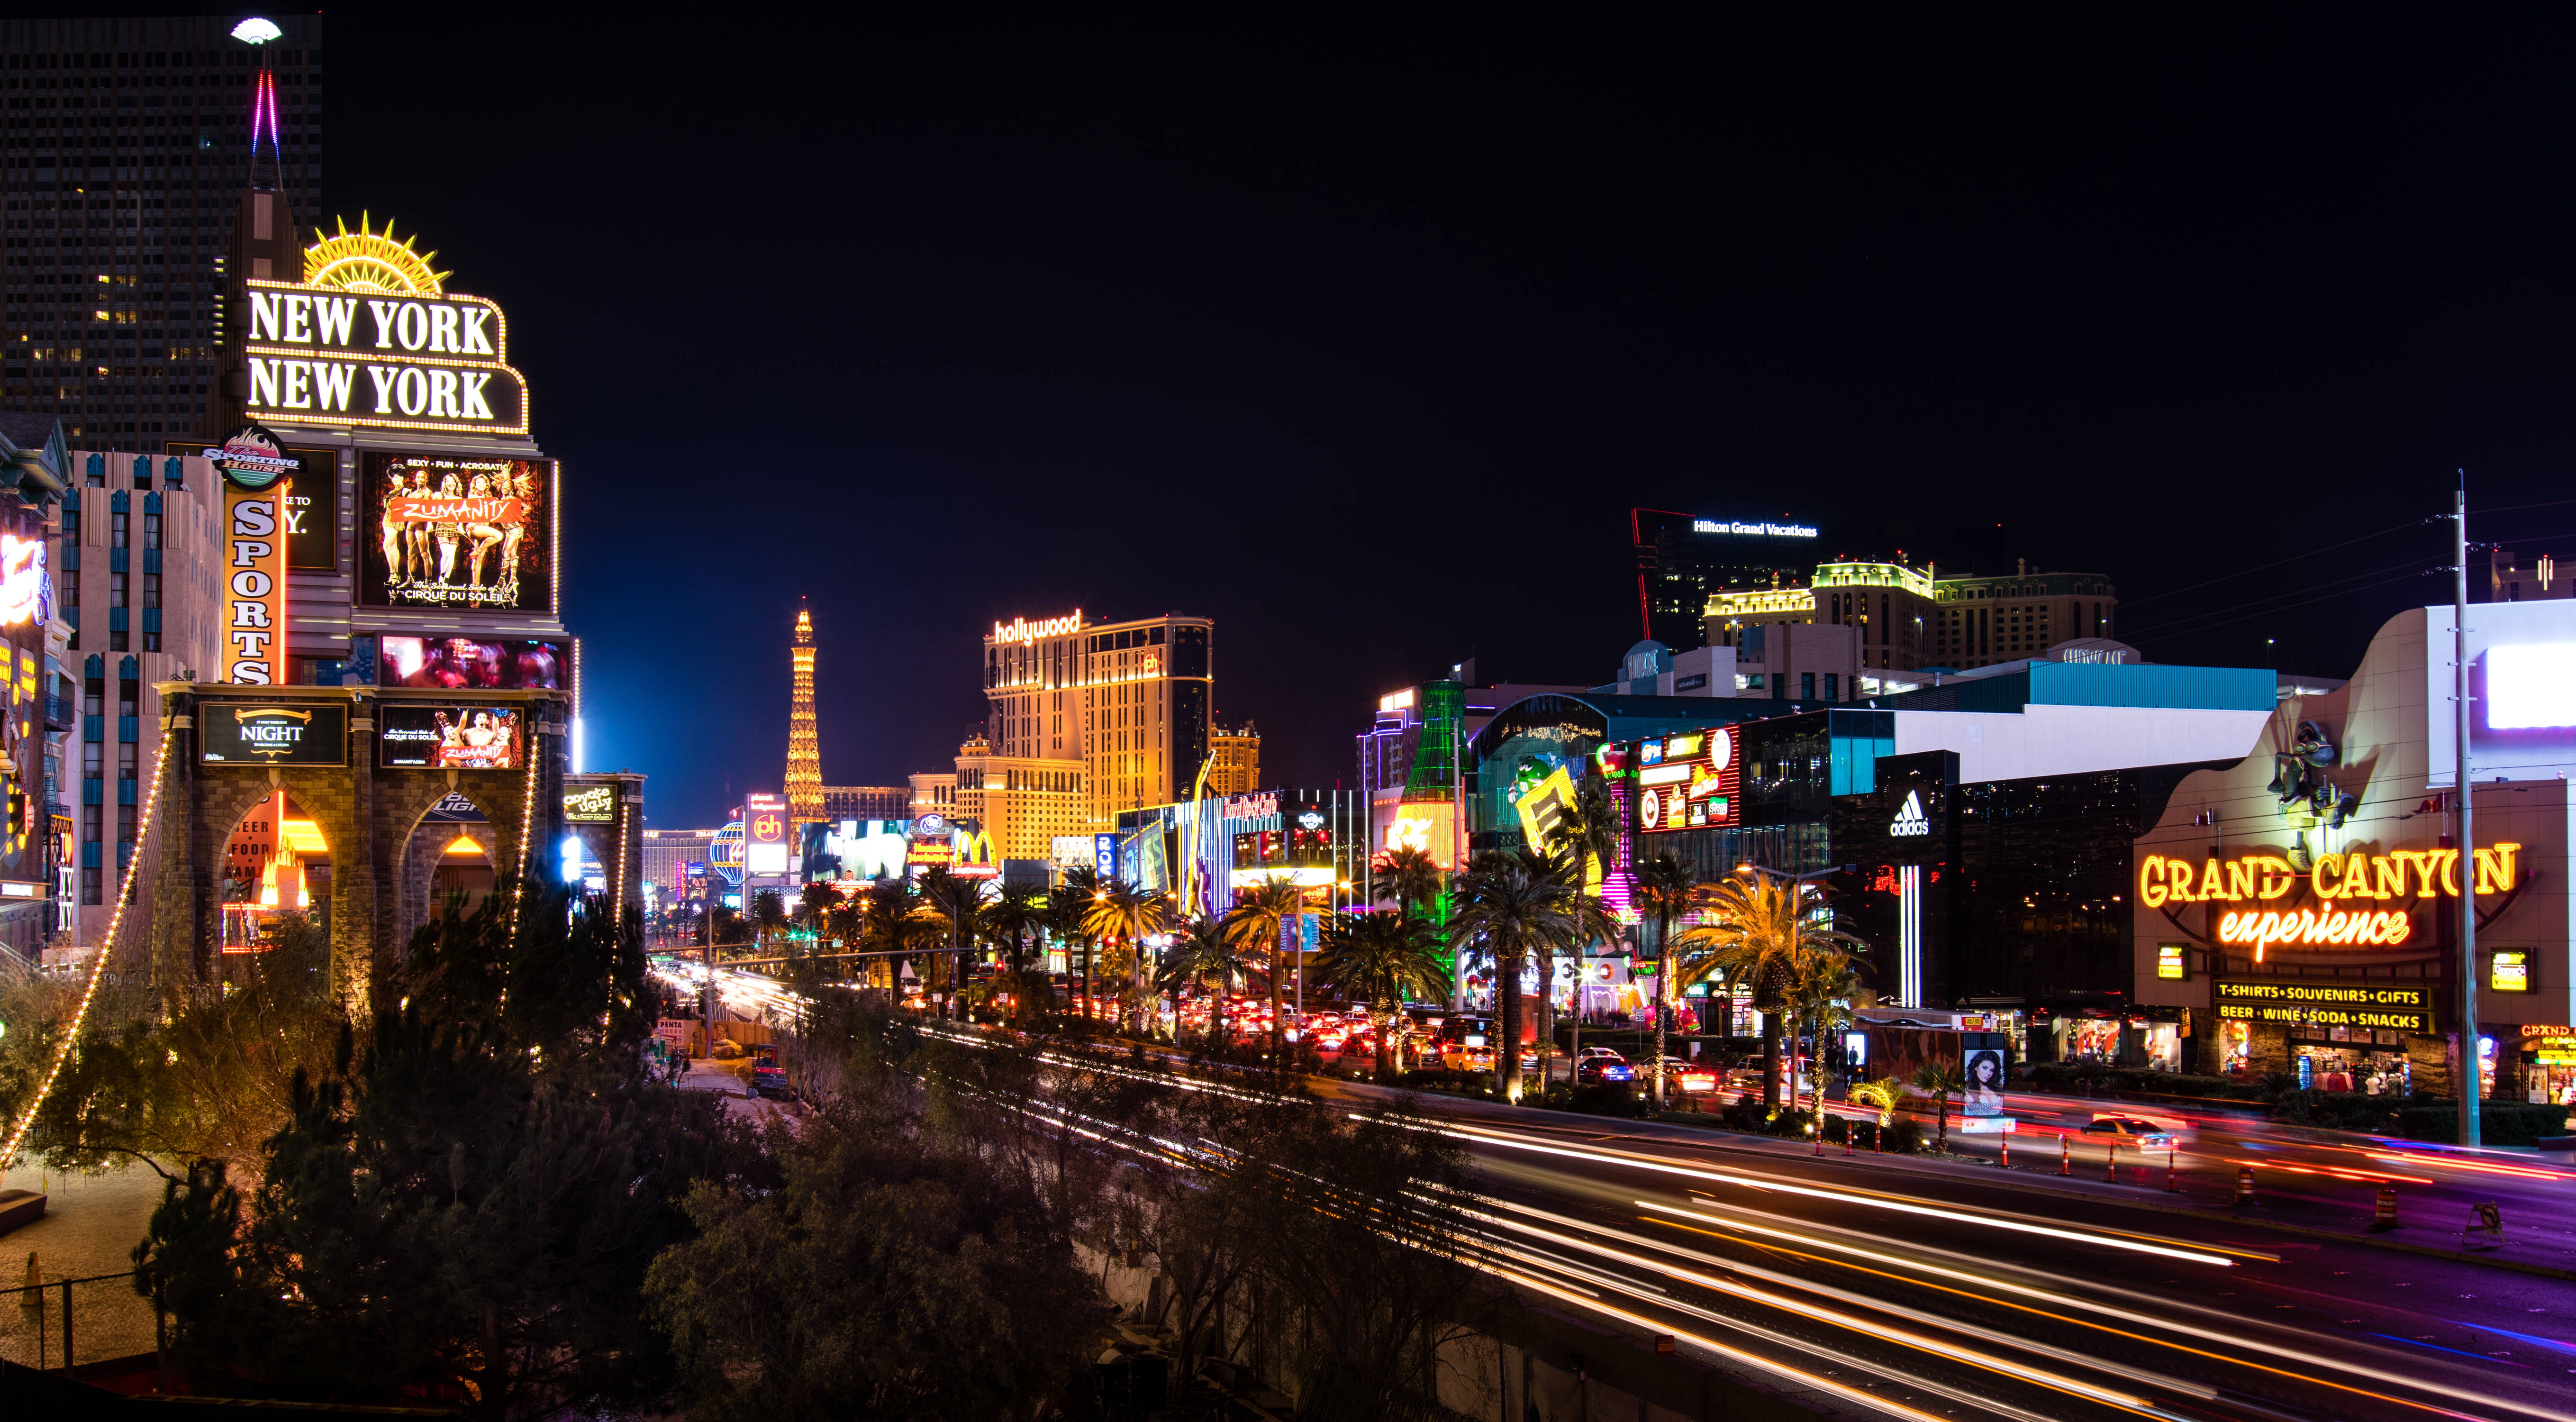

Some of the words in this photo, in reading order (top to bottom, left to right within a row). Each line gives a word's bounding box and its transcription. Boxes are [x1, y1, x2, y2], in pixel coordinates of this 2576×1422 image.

[249, 292, 357, 345] NEW
[368, 301, 493, 355] YORK
[248, 358, 356, 411] NEW
[368, 366, 493, 419] YORK
[202, 448, 299, 467] SPORTING
[228, 446, 260, 456] The
[222, 460, 285, 474] HOUSE
[407, 459, 429, 467] SEXY
[460, 462, 509, 471] ACROBATIC
[296, 497, 310, 505] TO
[403, 499, 510, 522] ZUMANITY
[1695, 520, 1730, 532] Hilton
[1732, 522, 1765, 534] Grand
[1767, 523, 1817, 537] Vacations
[232, 500, 275, 684] SPORTS
[405, 590, 447, 602] CIRQUE
[450, 592, 466, 601] DU
[414, 581, 430, 589] The
[468, 583, 487, 592] Side
[488, 584, 498, 593] of
[995, 609, 1080, 647] hollywood
[240, 725, 303, 741] NIGHT
[445, 746, 504, 758] ZUMANITY
[1667, 734, 1703, 757] SUBWAY
[563, 787, 610, 805] coyote
[578, 796, 612, 812] ugly
[433, 801, 480, 811] LIG
[1224, 796, 1242, 820] Hard
[1242, 795, 1259, 821] Rock
[1259, 793, 1277, 819] Cafe
[1693, 805, 1702, 816] 24
[757, 815, 782, 839] ph
[1890, 819, 1929, 837] adidas
[231, 844, 269, 856] FOOD
[2141, 855, 2293, 908] GRAND
[2220, 902, 2410, 963] experience
[2220, 984, 2278, 998] T-SHIRTS
[2287, 987, 2367, 1002] SOUVENIRS
[2376, 991, 2420, 1004] GIFTS
[2221, 1006, 2254, 1018] BEER
[2263, 1008, 2301, 1021] WINE
[2310, 1011, 2349, 1024] SODA
[2358, 1013, 2420, 1028] SNACKS
[2522, 1025, 2569, 1036] GRAND
